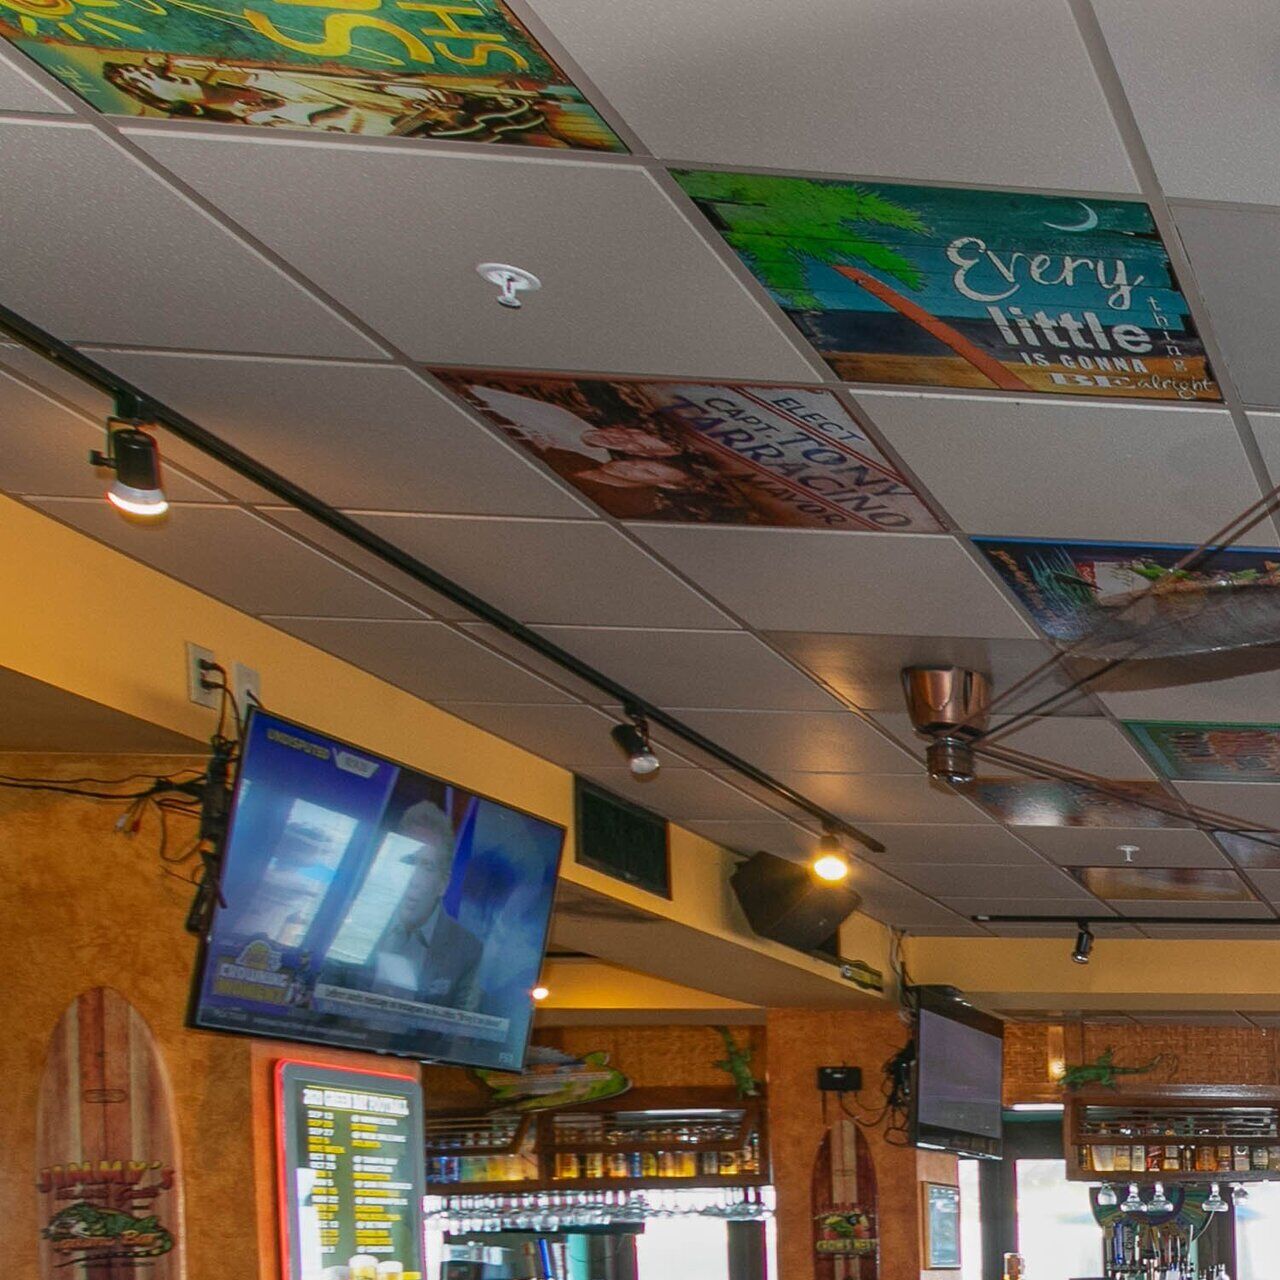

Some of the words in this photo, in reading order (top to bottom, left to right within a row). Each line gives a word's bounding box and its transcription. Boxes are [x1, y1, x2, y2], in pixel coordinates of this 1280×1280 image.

[947, 237, 1145, 310] Every
[987, 306, 1153, 354] little
[1148, 297, 1188, 373] thing
[1020, 352, 1050, 367] IS
[1059, 352, 1148, 374] GONNA
[1051, 372, 1136, 390] BE
[1137, 375, 1215, 401] alright
[703, 397, 781, 440] CAPT.
[777, 431, 917, 497] TONY
[772, 396, 865, 442] ELECT
[657, 394, 912, 528] TARRACINO
